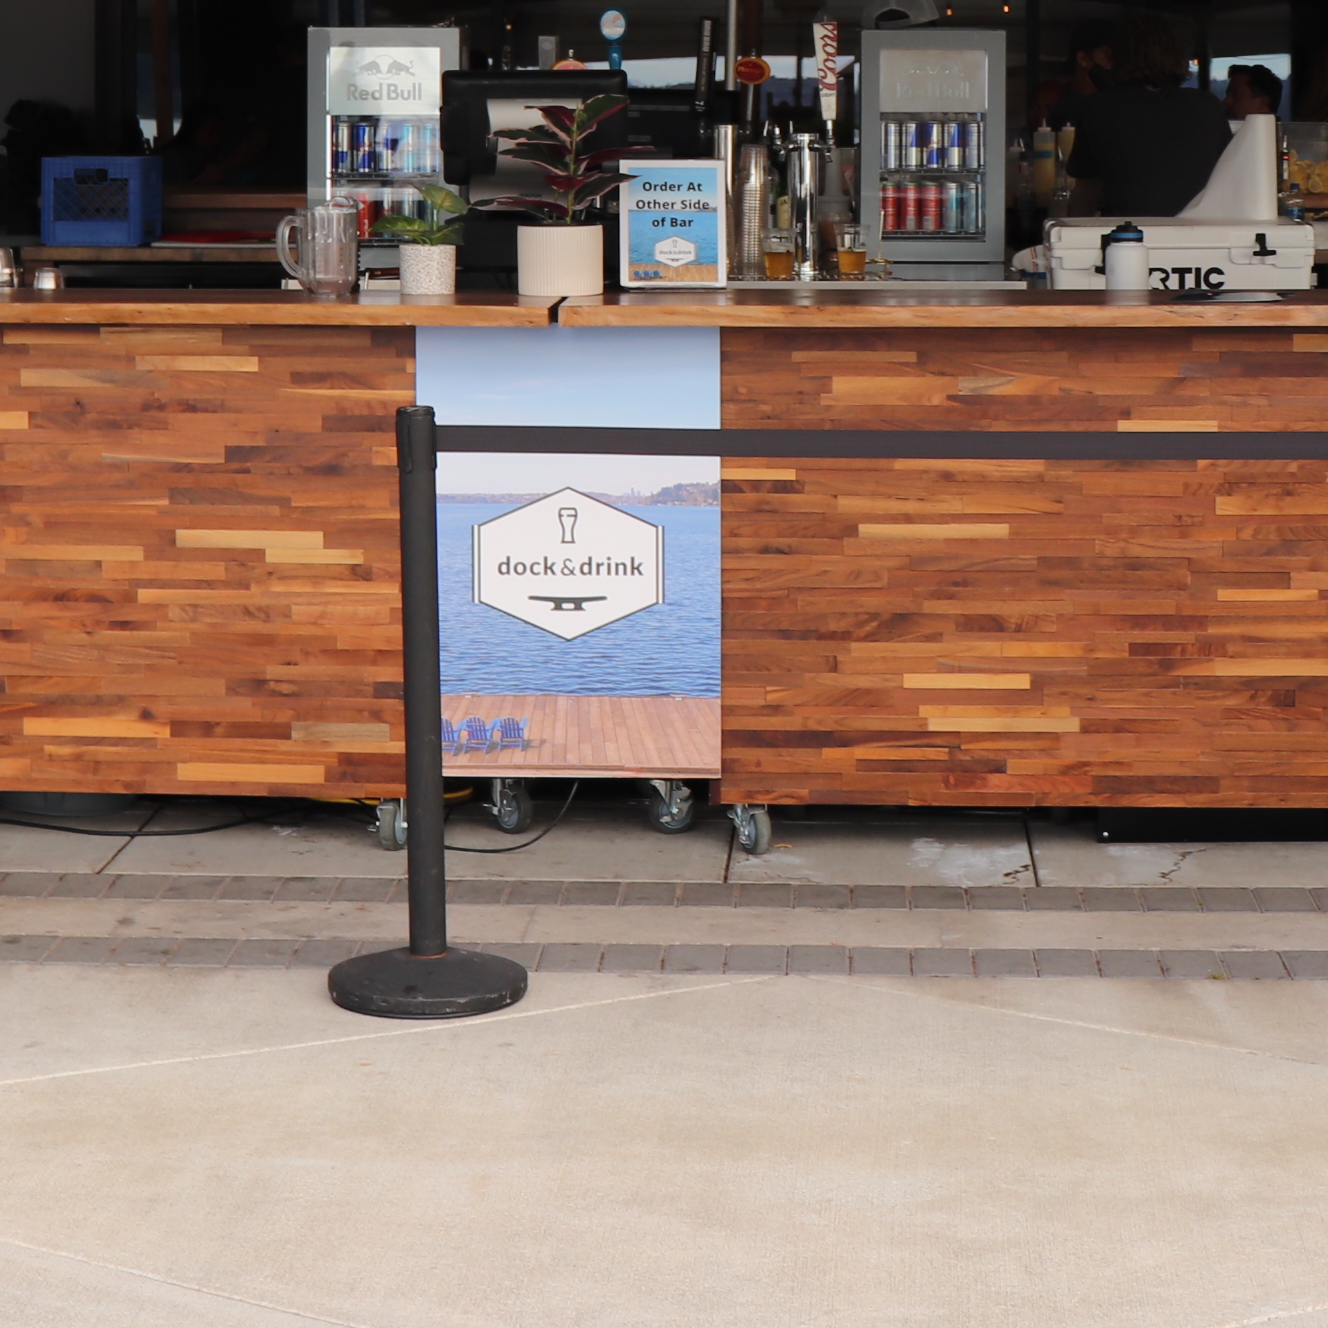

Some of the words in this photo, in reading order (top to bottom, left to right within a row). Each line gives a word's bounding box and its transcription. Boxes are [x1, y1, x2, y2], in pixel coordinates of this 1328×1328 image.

[818, 22, 838, 91] Coors
[346, 83, 383, 101] Red
[386, 83, 422, 101] Bull
[642, 181, 683, 192] Order
[686, 182, 703, 192] At
[635, 199, 676, 210] Other
[680, 199, 710, 210] Side
[651, 217, 666, 227] of
[670, 217, 694, 227] Bar
[1148, 267, 1225, 290] RTIC
[497, 555, 644, 576] dock&drink
